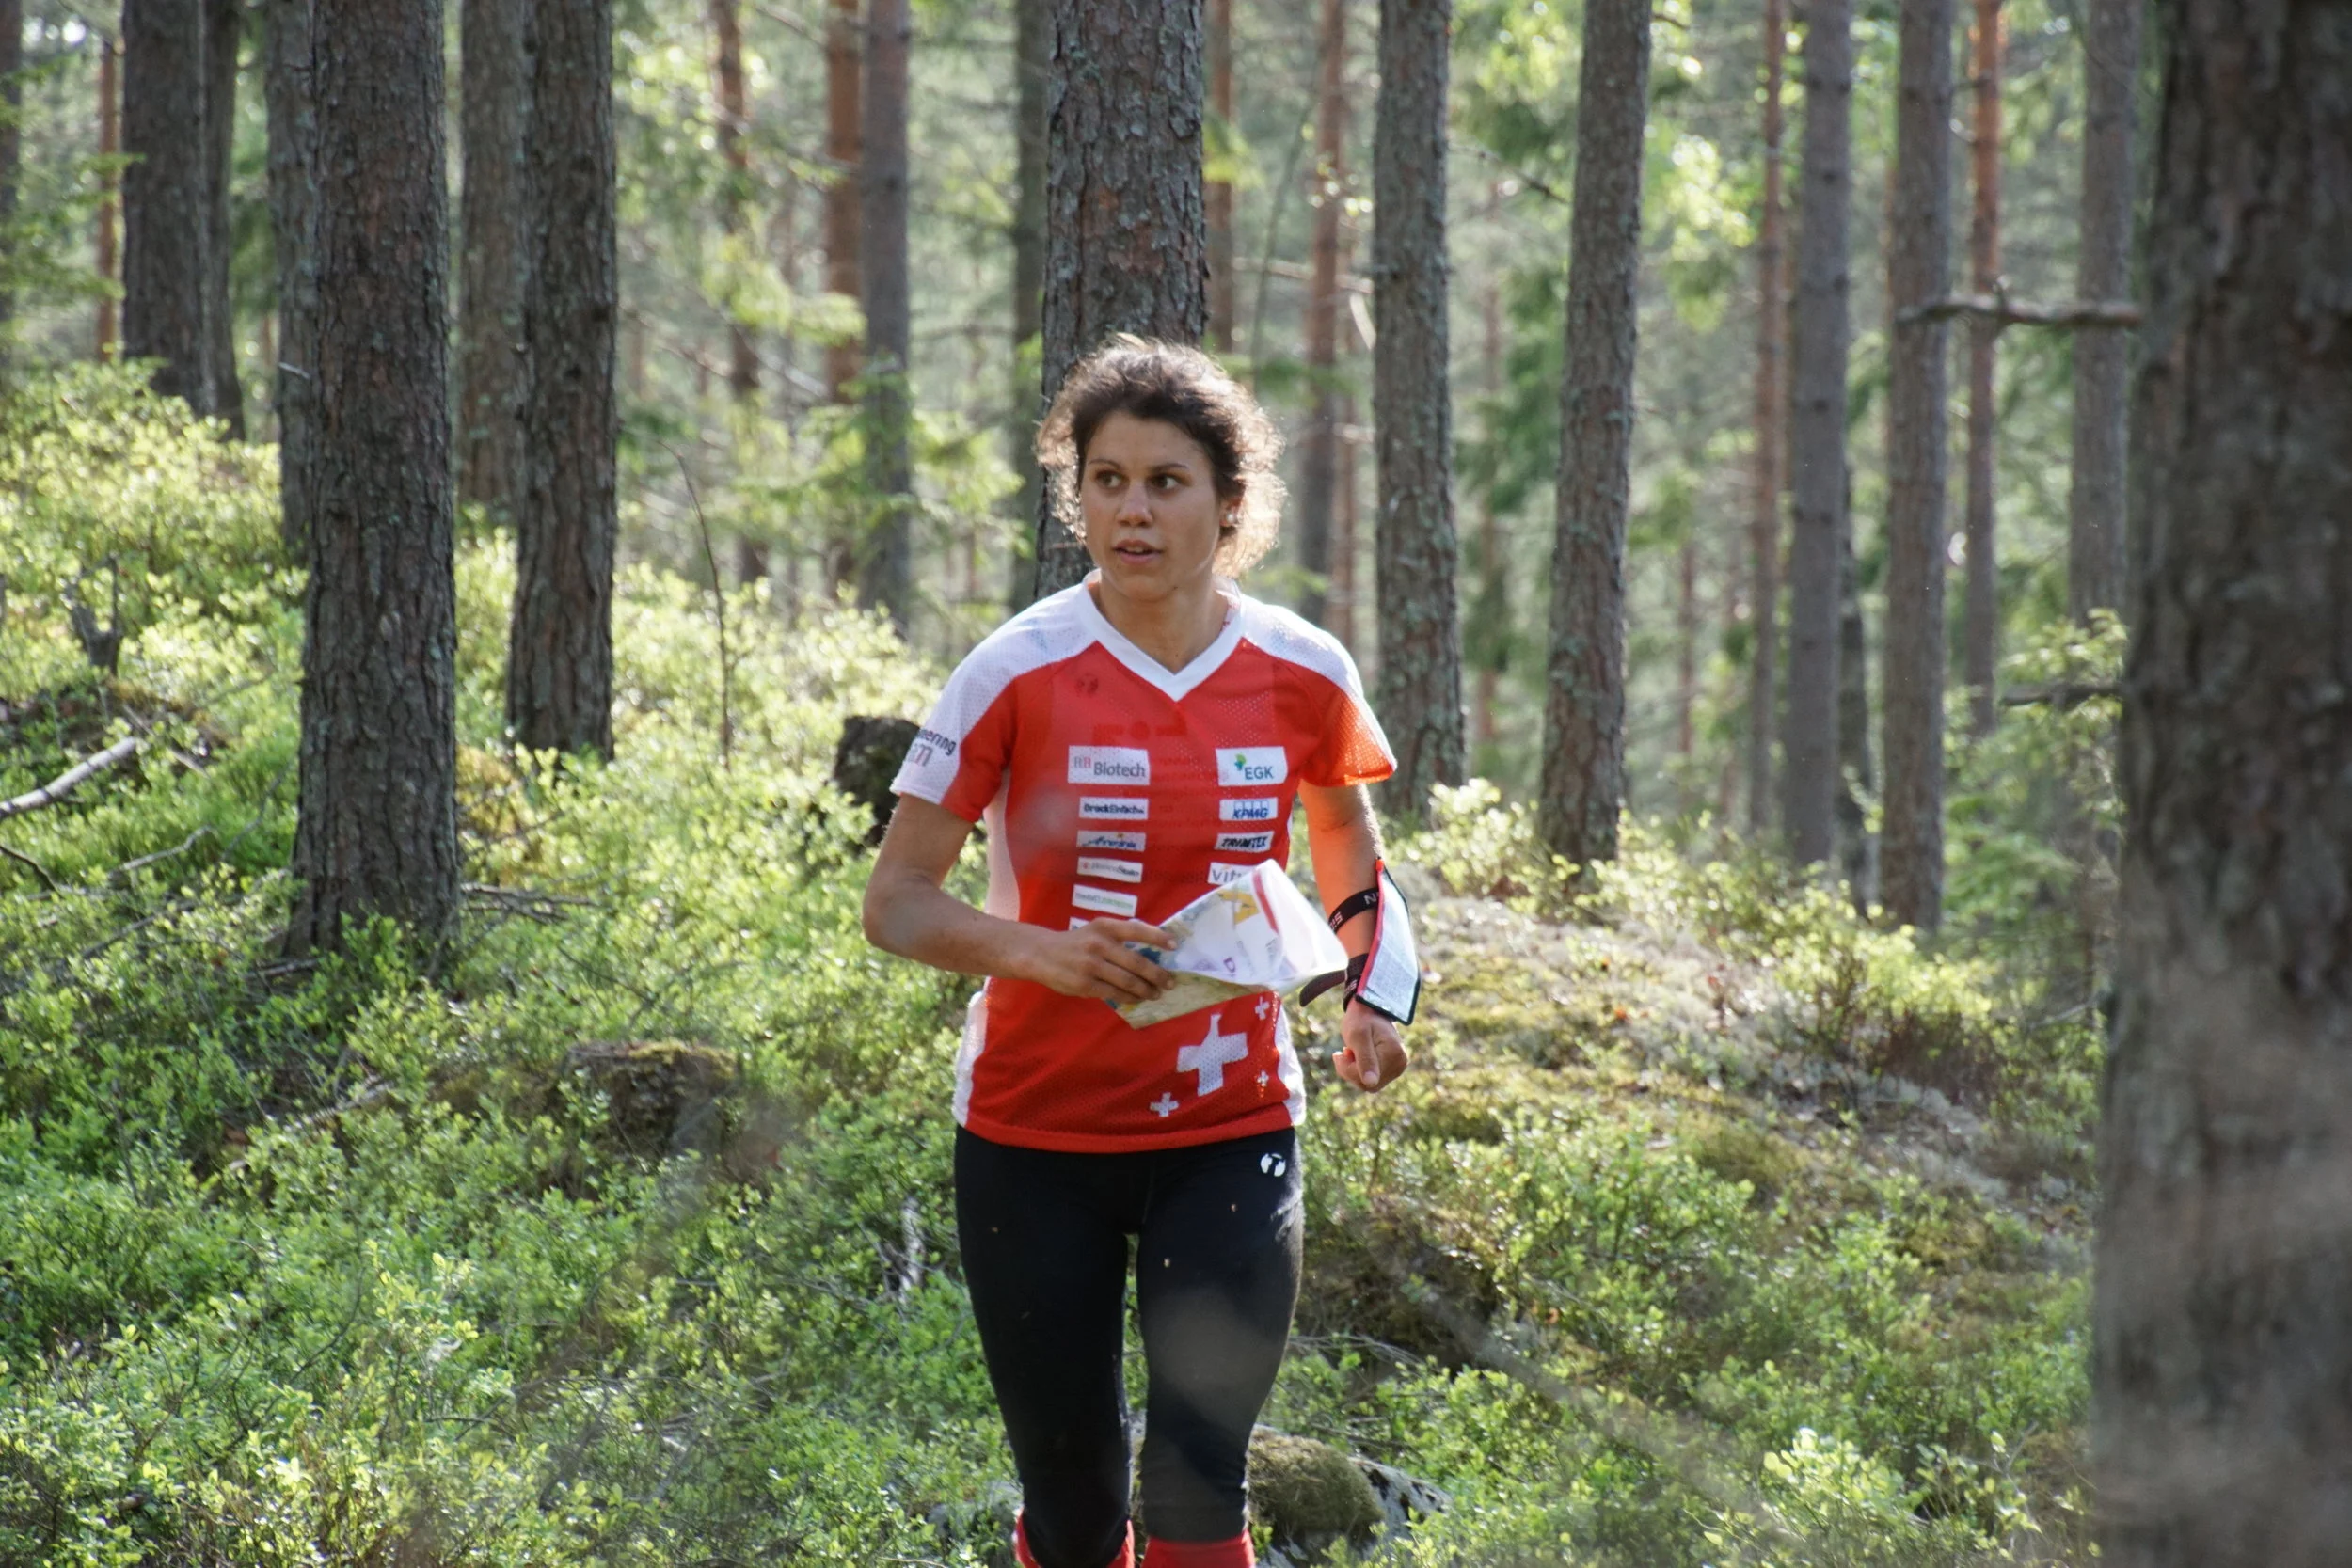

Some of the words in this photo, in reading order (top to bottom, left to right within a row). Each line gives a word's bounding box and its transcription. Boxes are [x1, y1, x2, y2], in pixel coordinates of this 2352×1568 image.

[1093, 762, 1146, 778] Biotech
[1244, 766, 1274, 781] EGK
[1232, 808, 1269, 820] KPMG
